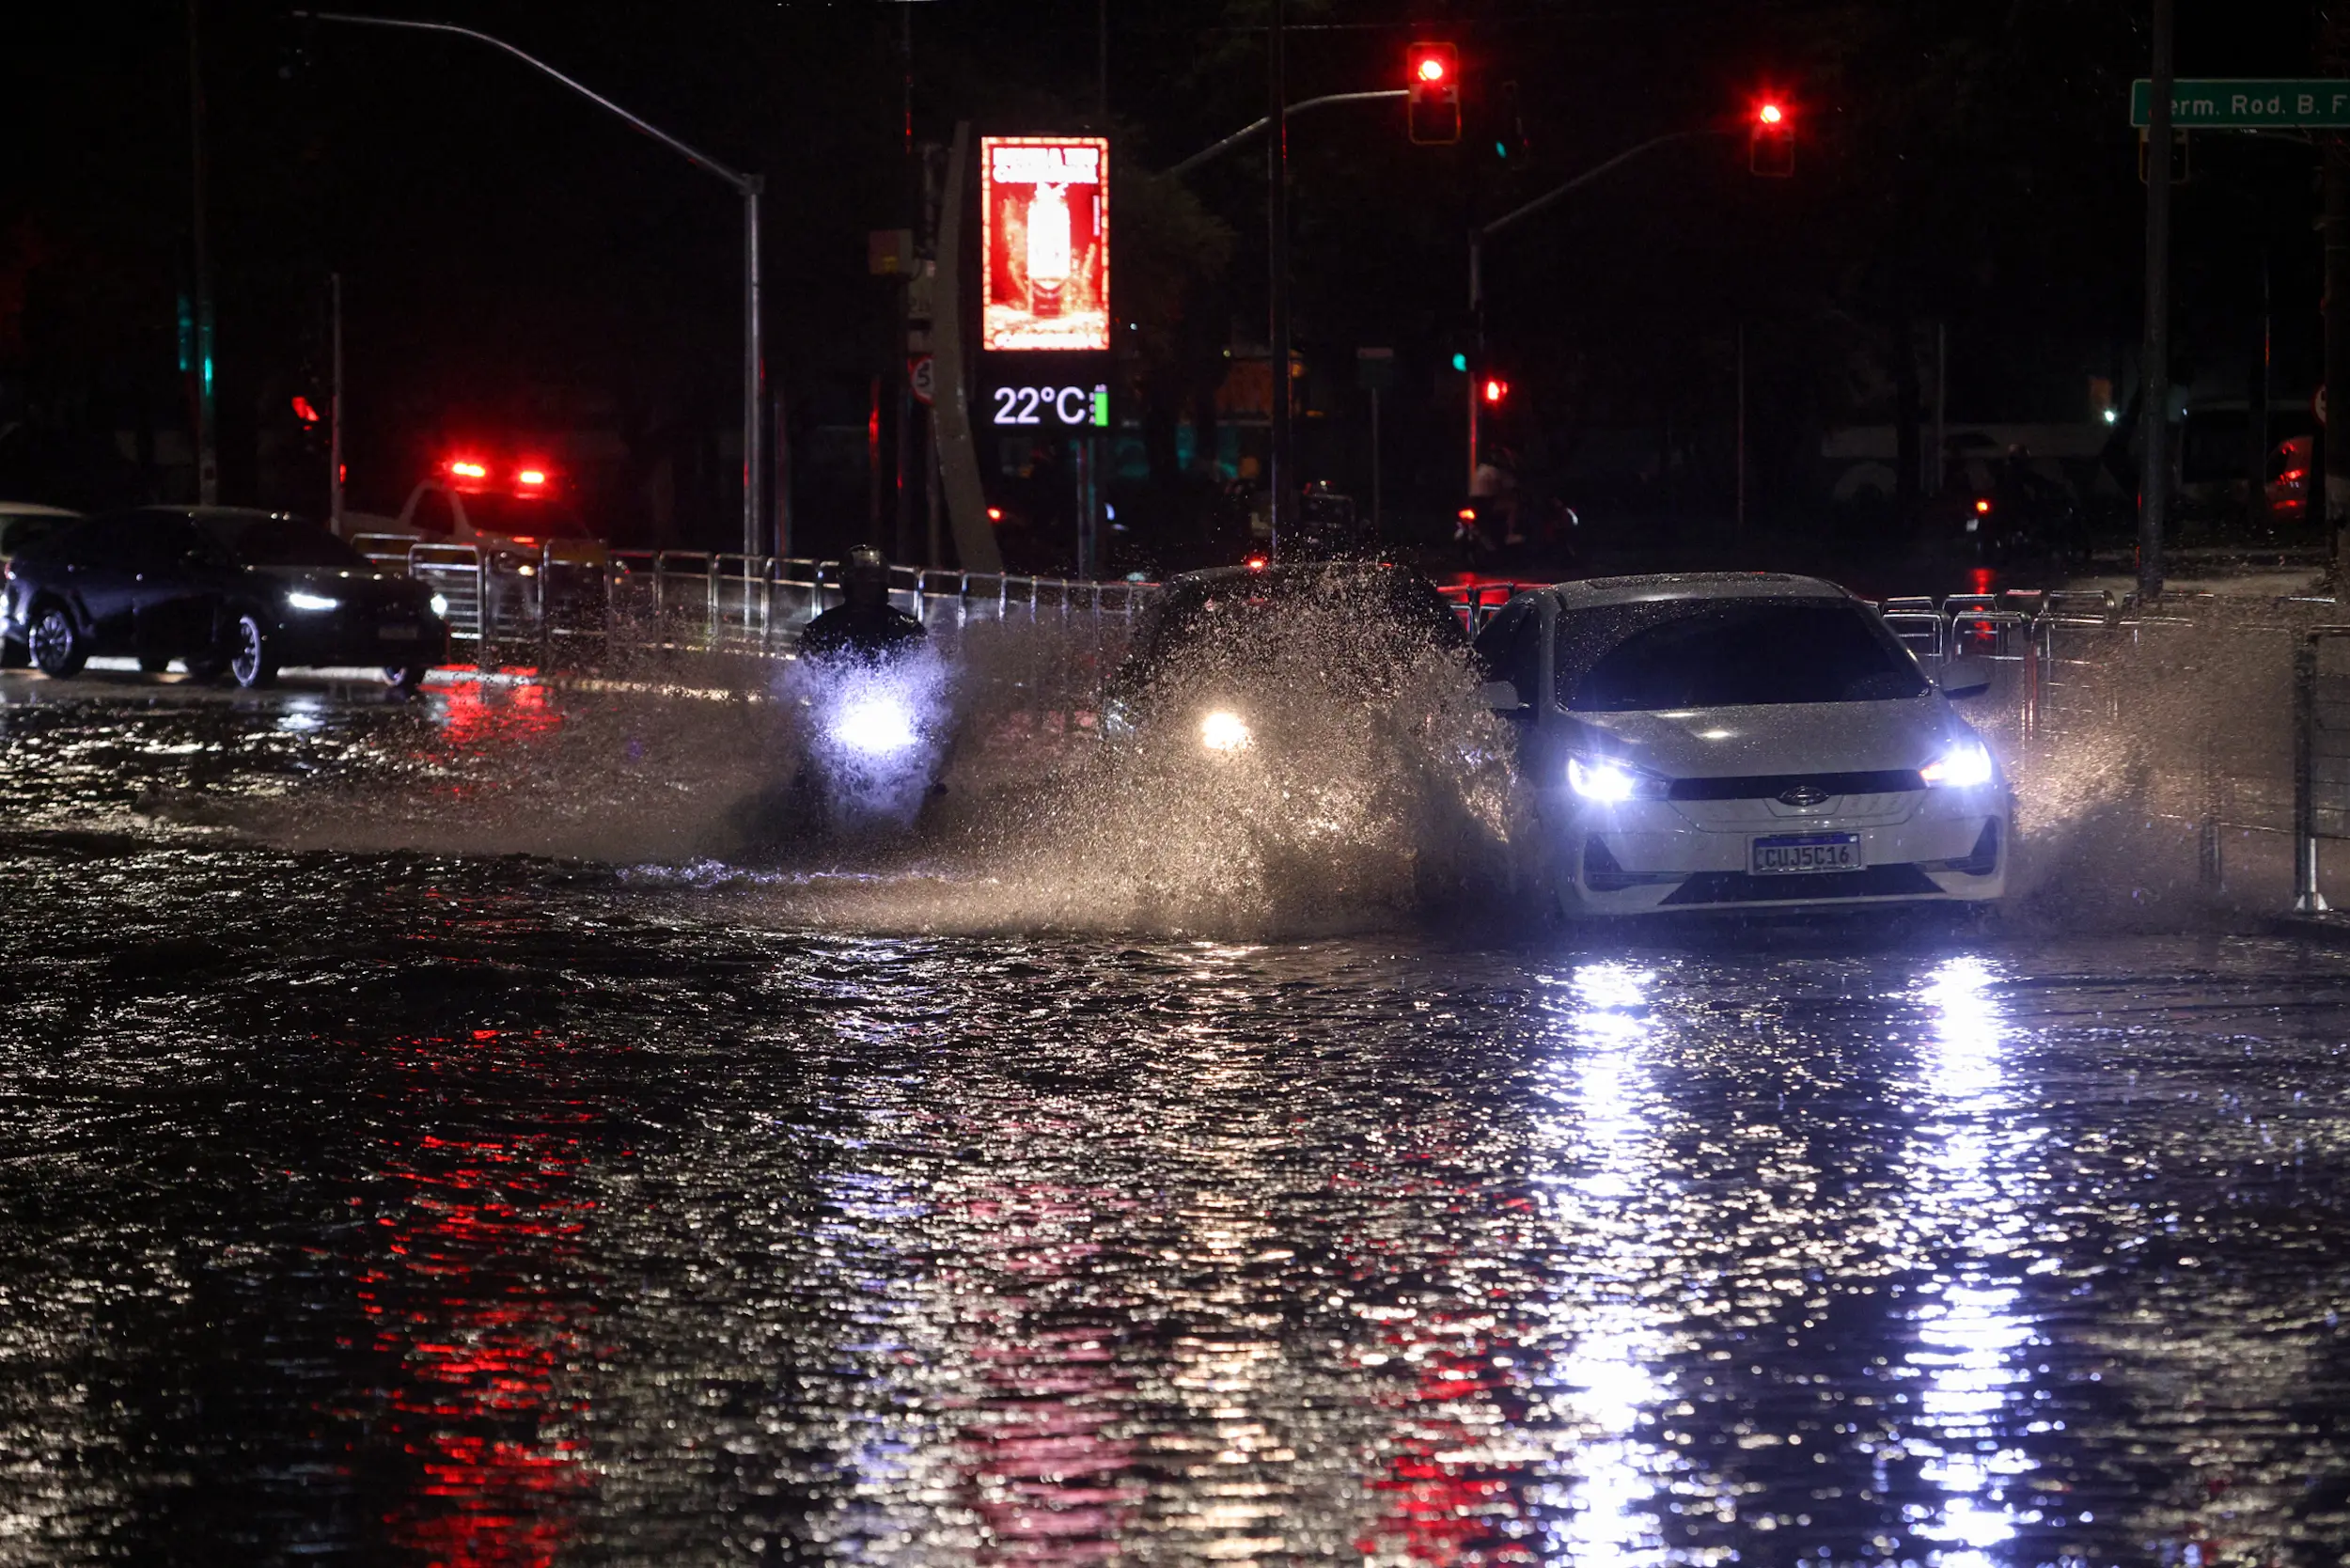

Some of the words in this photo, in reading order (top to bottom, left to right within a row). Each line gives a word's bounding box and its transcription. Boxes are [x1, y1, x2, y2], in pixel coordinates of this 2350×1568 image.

[2170, 98, 2220, 116] erm.
[2231, 94, 2286, 115] Rod.
[2296, 94, 2321, 115] B.
[994, 385, 1087, 425] 22°C
[1765, 846, 1849, 867] CUJ5C16
